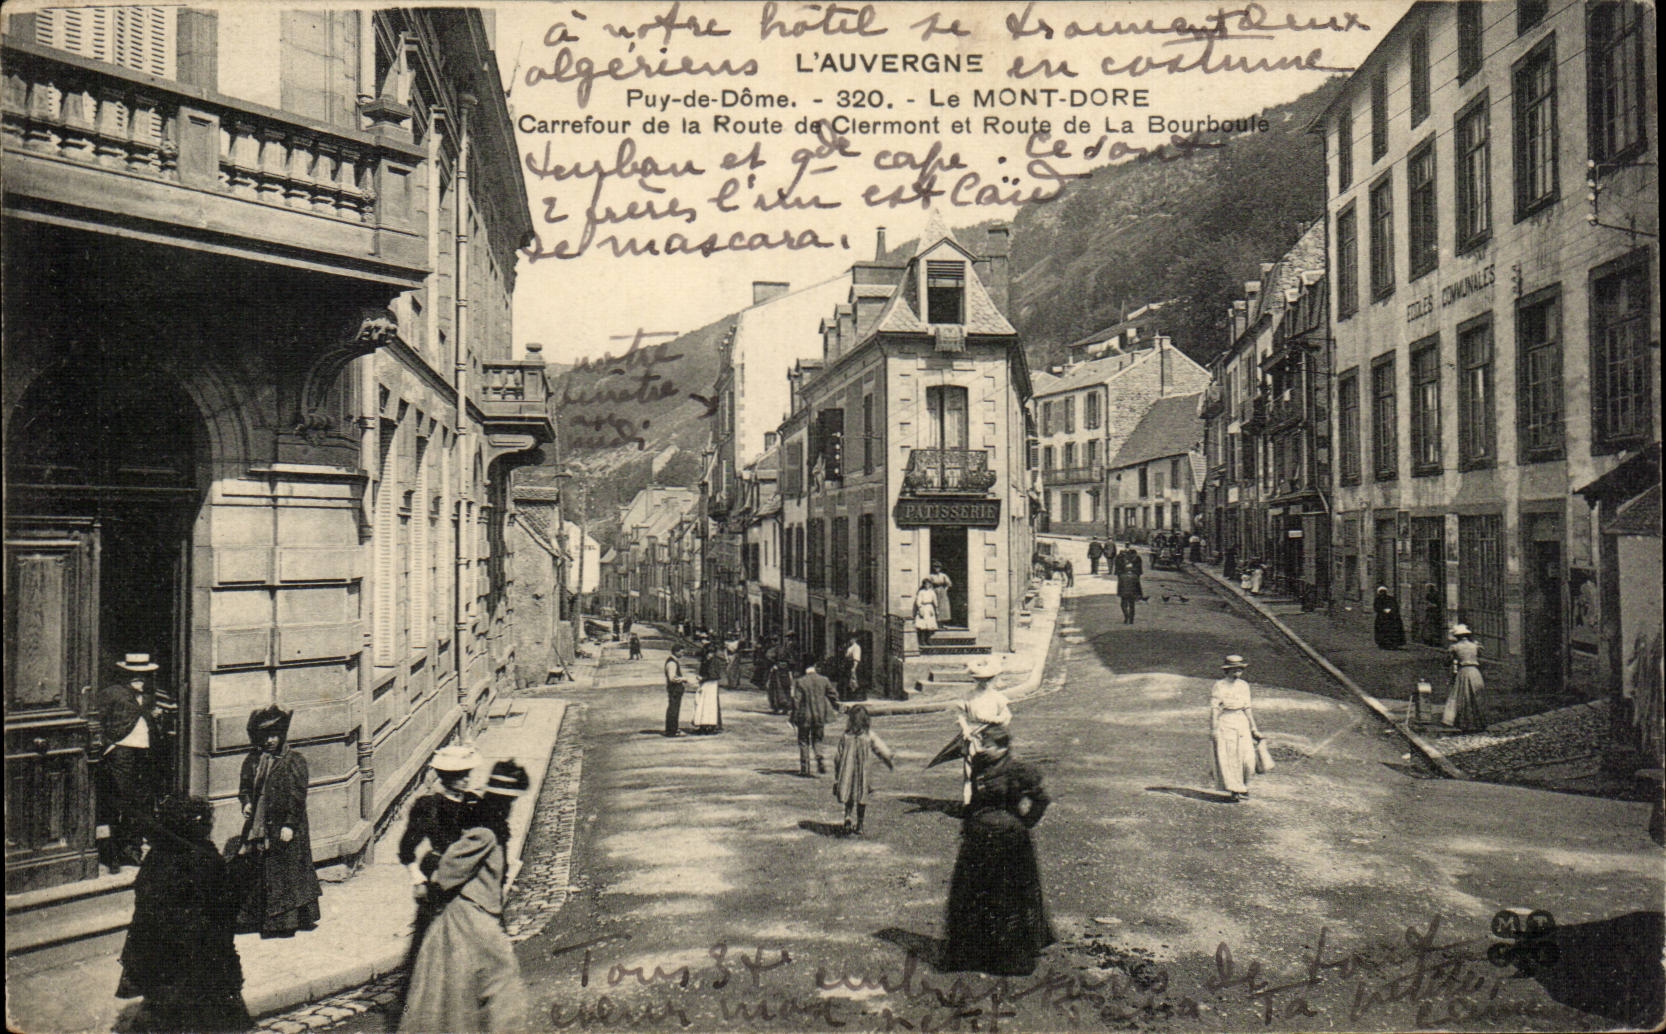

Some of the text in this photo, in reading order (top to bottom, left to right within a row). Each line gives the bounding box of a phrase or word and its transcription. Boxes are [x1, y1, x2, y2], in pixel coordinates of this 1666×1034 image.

[603, 2, 731, 44] notre
[761, 3, 889, 42] hôtel
[911, 11, 971, 42] se
[1007, 55, 1078, 78] en
[1101, 36, 1356, 77] costume
[720, 141, 767, 171] et
[861, 173, 946, 210] est
[905, 504, 995, 519] PATISSERIE
